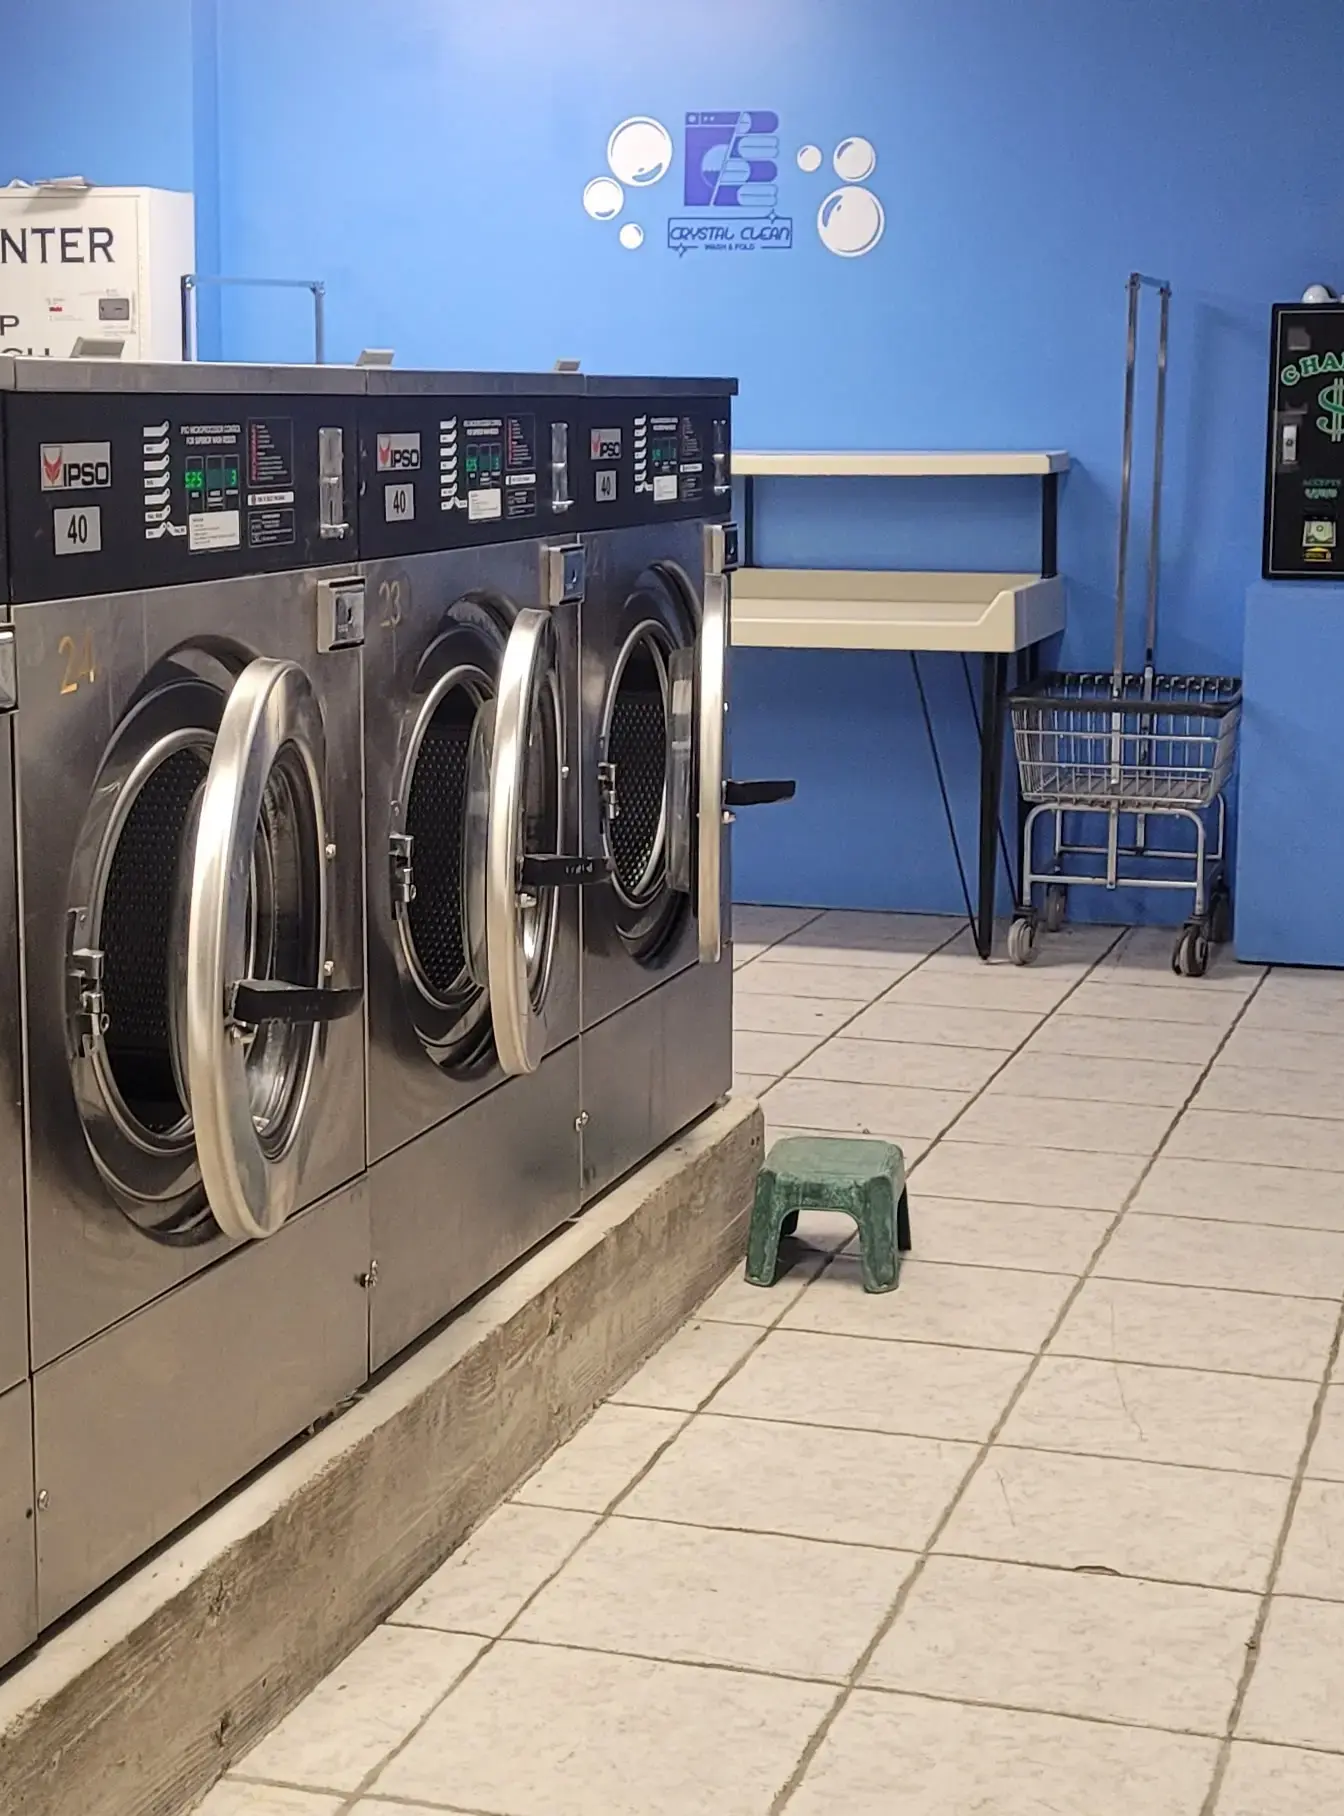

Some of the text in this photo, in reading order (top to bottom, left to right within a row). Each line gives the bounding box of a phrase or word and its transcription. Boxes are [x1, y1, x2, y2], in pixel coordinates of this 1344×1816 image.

[670, 226, 790, 241] CRYSTAL CLEAN
[391, 449, 419, 467] IPSO
[64, 462, 109, 487] IPSO
[393, 490, 406, 514] 40
[68, 514, 88, 544] 40
